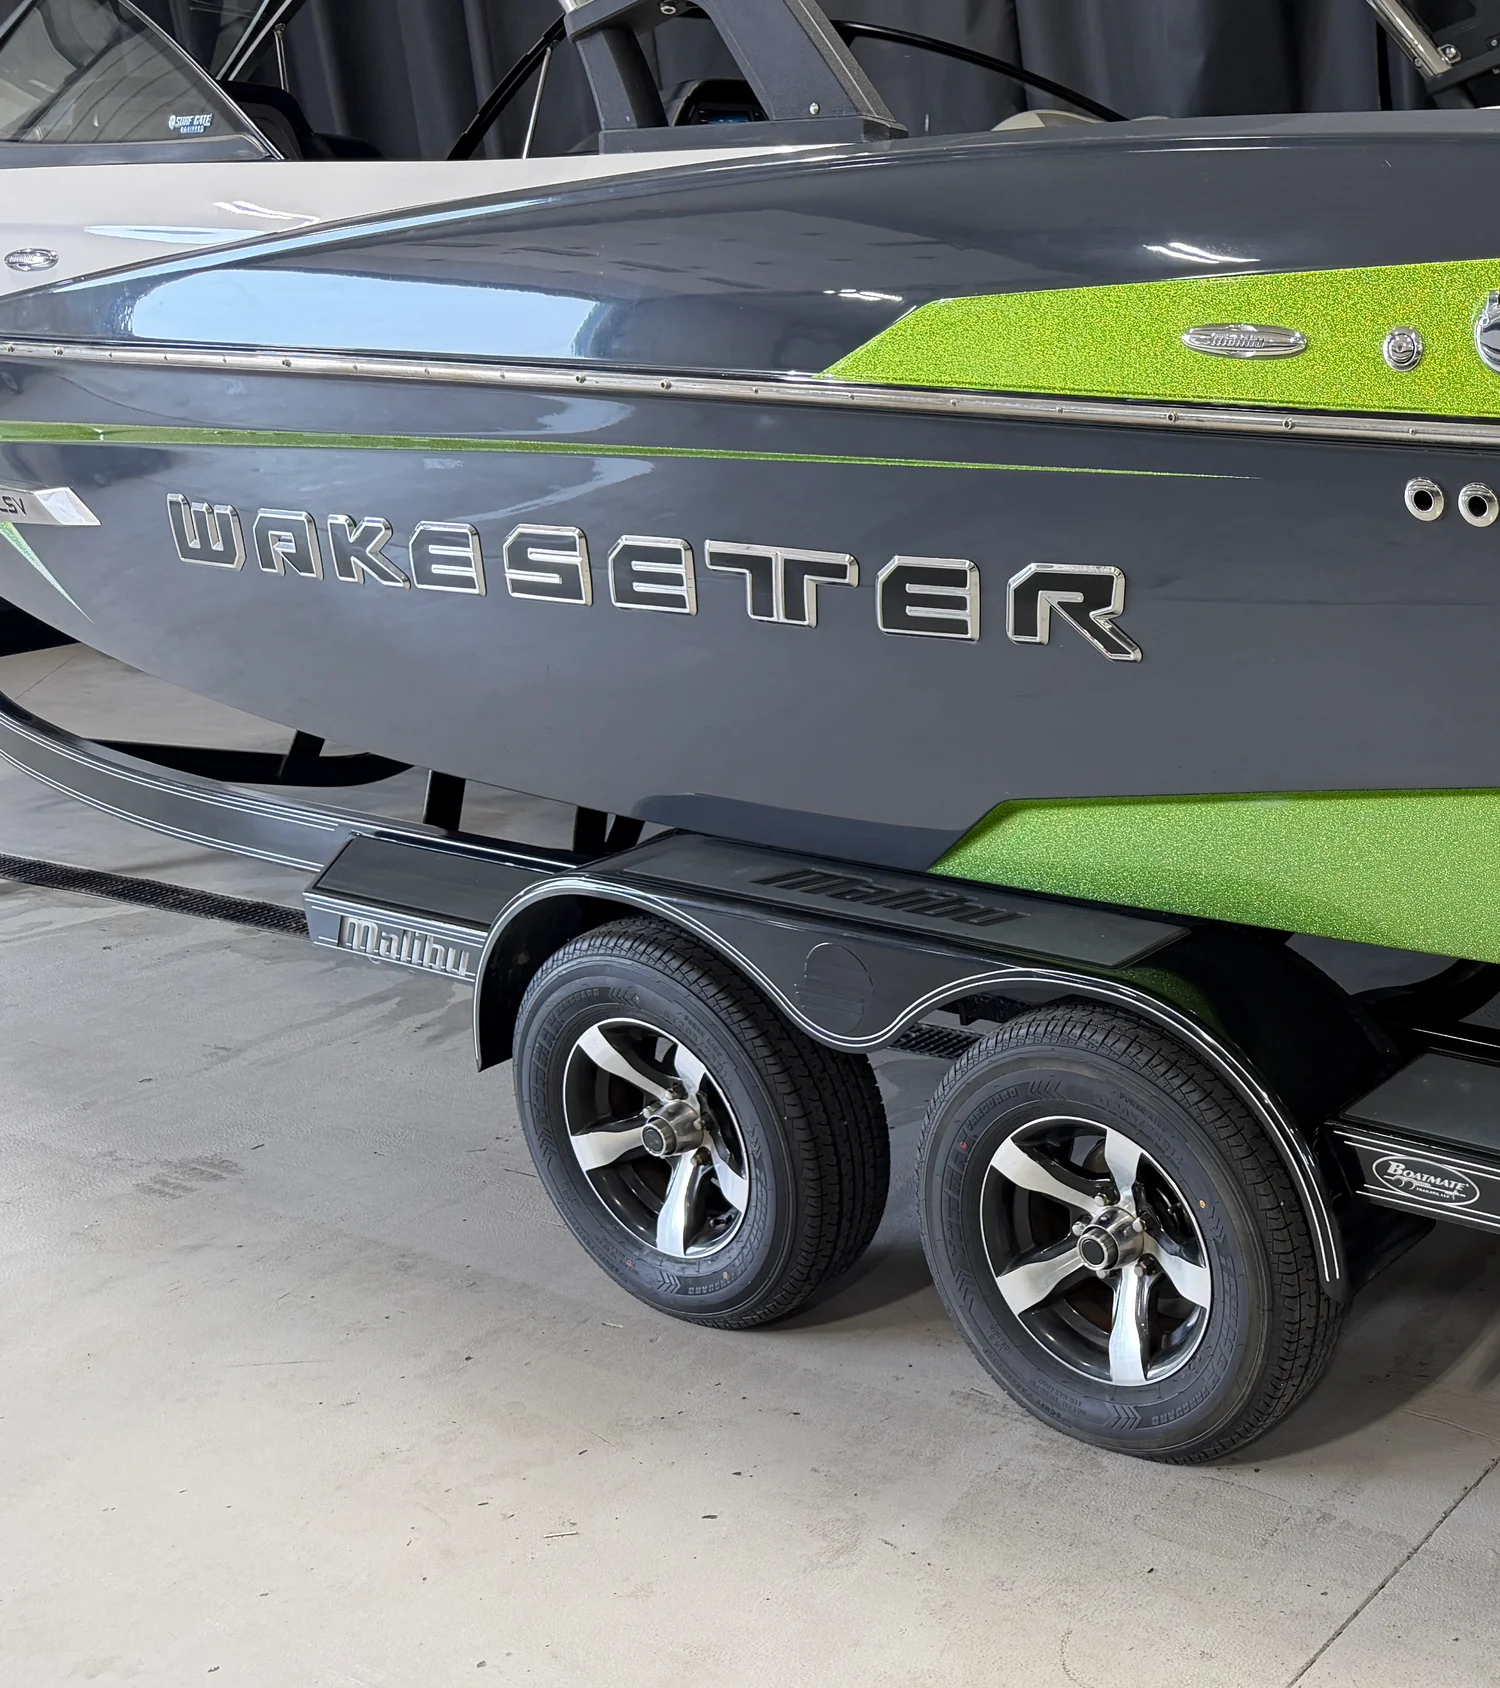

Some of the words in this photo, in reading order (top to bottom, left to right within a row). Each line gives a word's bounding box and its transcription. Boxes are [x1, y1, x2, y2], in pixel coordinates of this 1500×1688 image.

[166, 492, 1143, 663] WAKESETTER
[967, 1086, 1019, 1131] VANGUARD
[1386, 1160, 1465, 1191] BOATMATE
